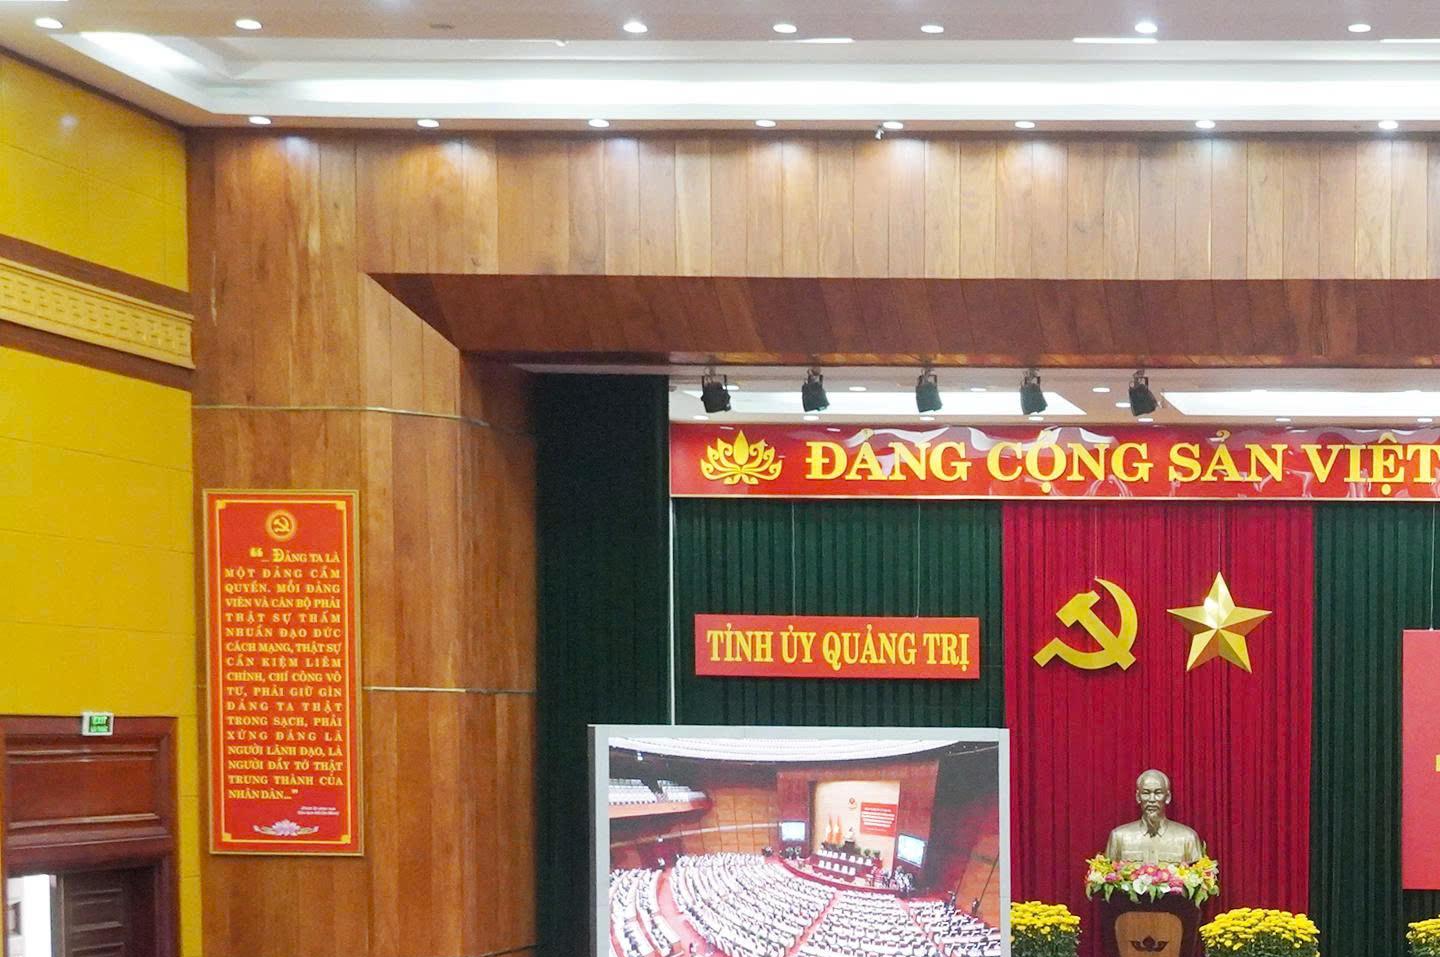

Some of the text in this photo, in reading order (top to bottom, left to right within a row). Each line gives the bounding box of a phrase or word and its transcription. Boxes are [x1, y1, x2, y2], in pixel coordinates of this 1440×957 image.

[805, 427, 972, 482] ĐẢNG
[987, 428, 1153, 494] CỘNG
[1169, 430, 1288, 484] SẢN
[706, 623, 970, 672] TỈNH ỦY QUẢNG TRỊ
